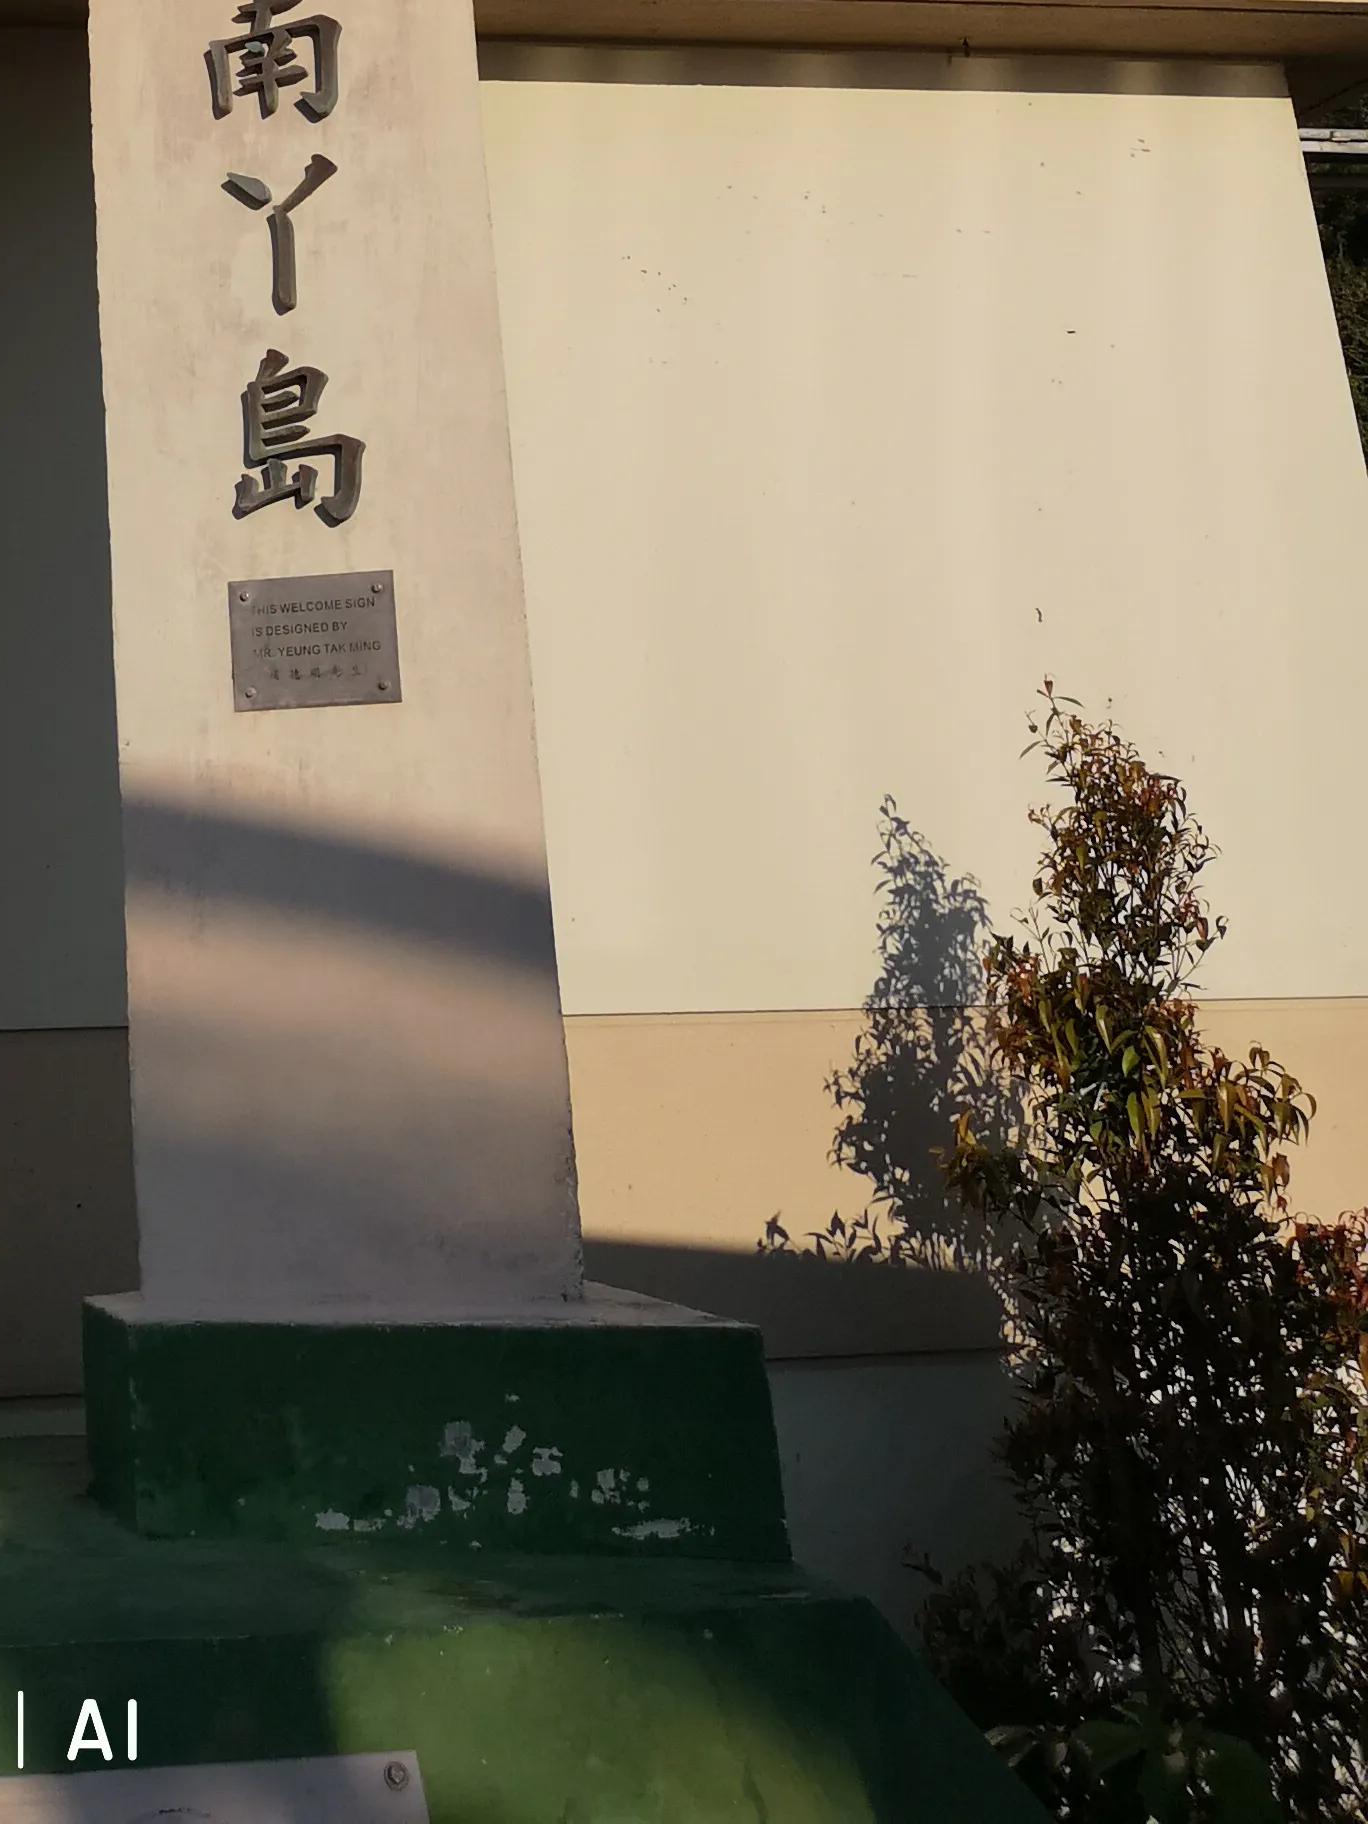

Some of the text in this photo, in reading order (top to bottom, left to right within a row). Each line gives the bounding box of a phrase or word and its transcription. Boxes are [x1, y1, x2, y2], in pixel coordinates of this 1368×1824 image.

[251, 596, 376, 616] THIS WELCOME SIGN
[251, 620, 348, 637] IS DESIGNED BY
[277, 645, 321, 657] YEUNG
[323, 643, 347, 654] TAK
[349, 640, 382, 653] MING
